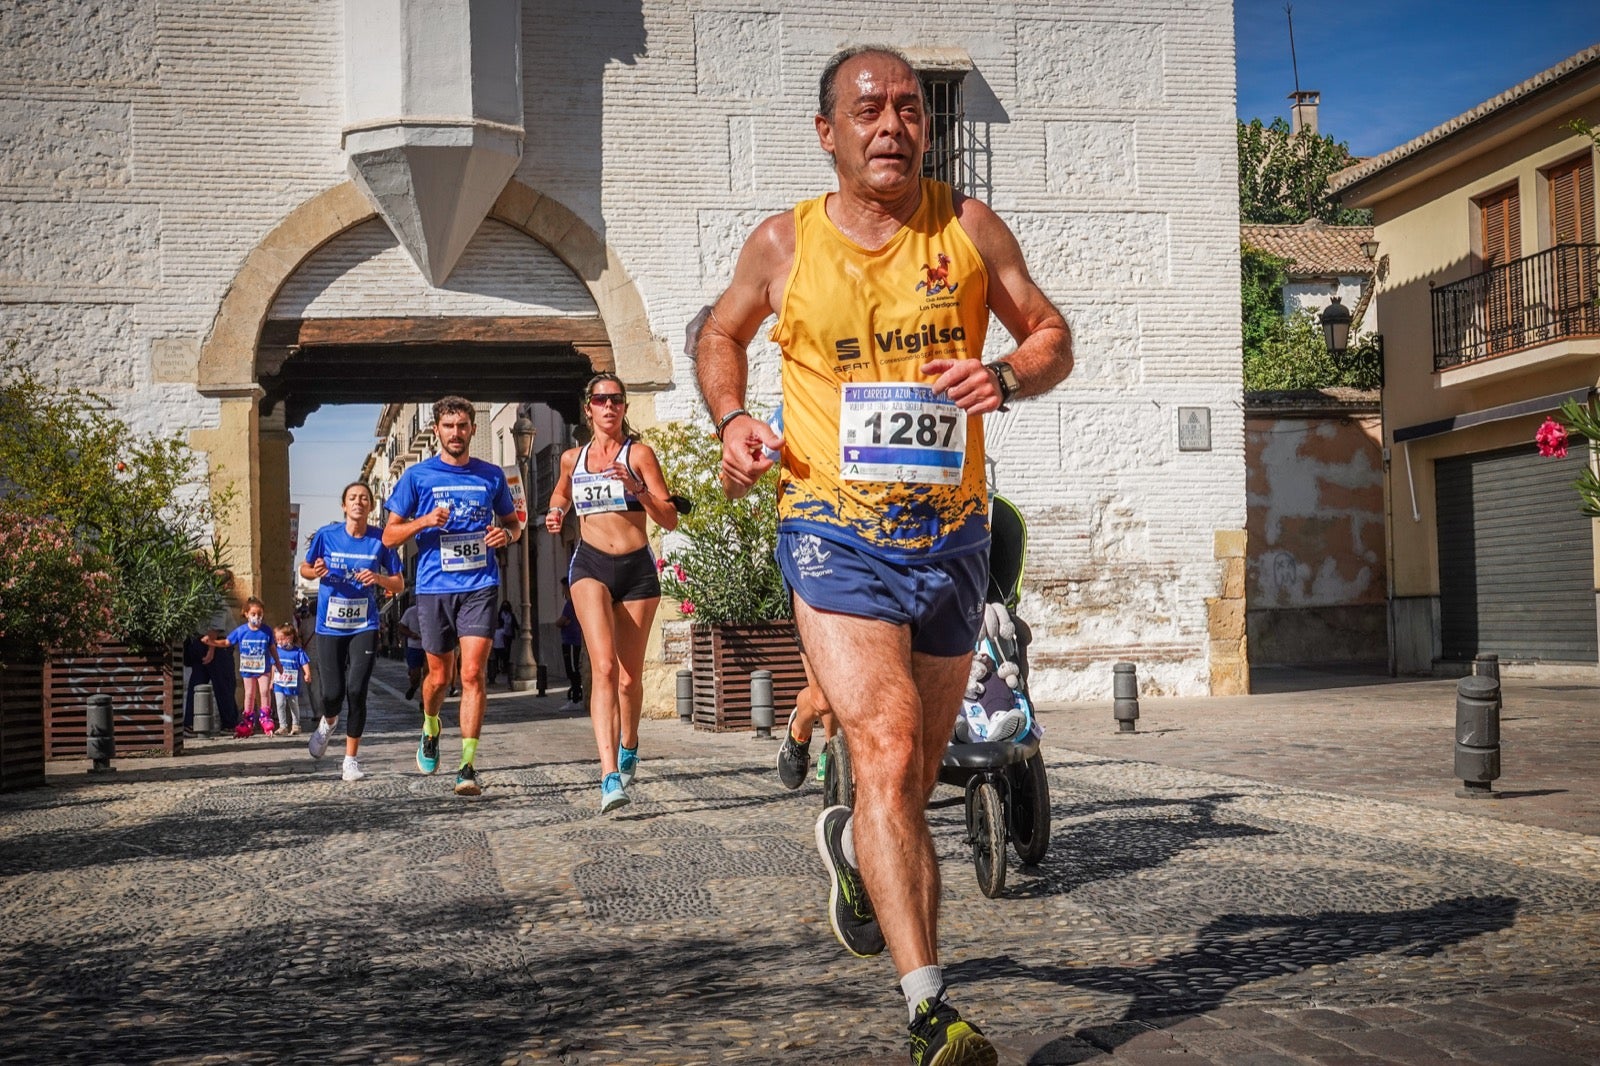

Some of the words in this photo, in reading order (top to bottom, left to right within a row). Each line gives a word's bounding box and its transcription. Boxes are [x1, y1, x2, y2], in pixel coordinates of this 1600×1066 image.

[874, 324, 966, 354] Vigilsa
[833, 361, 871, 374] SEAT
[852, 389, 860, 399] VI
[863, 389, 892, 399] CARRERA
[864, 411, 958, 448] 1287
[583, 485, 612, 501] 371
[453, 543, 480, 557] 585
[337, 607, 361, 618] 584
